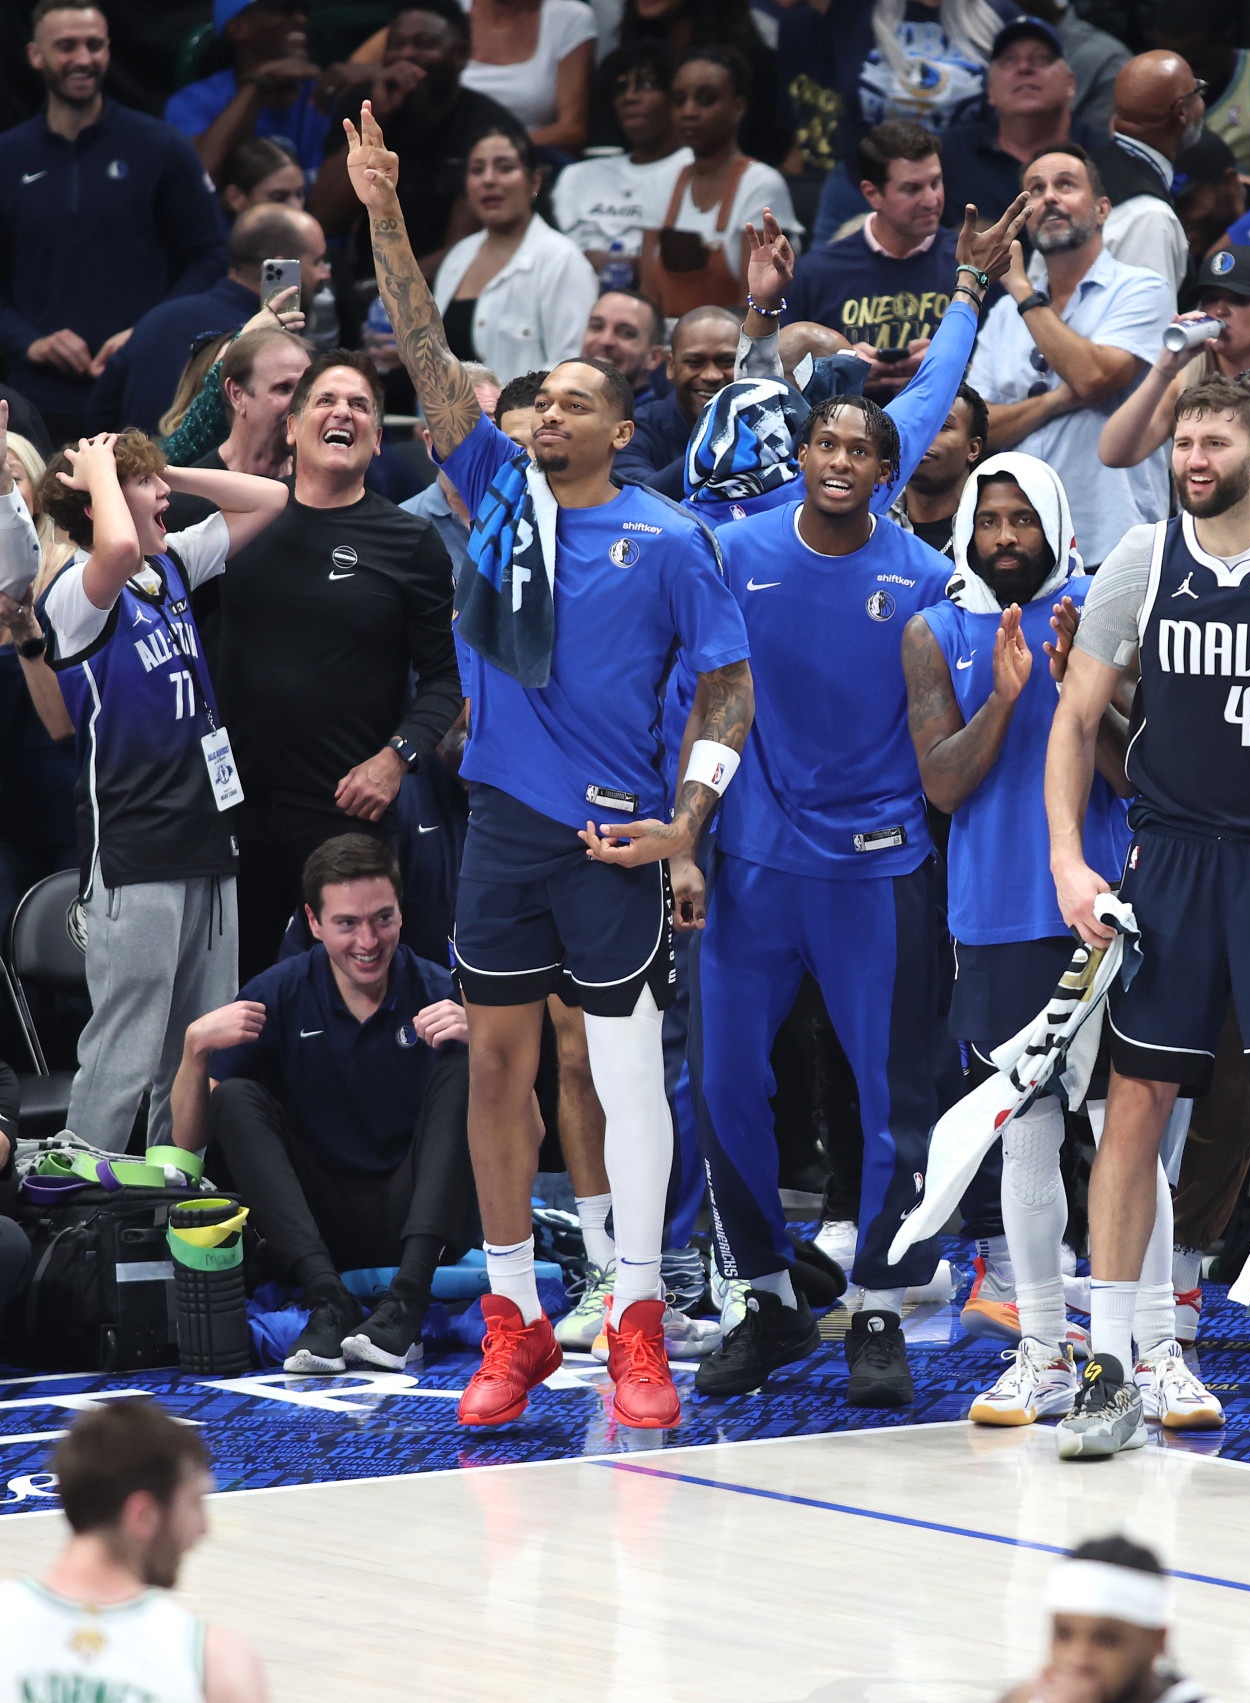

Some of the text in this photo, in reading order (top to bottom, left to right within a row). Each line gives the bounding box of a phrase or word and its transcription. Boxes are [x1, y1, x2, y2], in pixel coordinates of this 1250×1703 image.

[842, 292, 951, 327] ONE FO
[622, 521, 663, 536] shiftkey
[876, 573, 916, 588] shiftkey
[169, 670, 196, 720] 77
[712, 1206, 739, 1278] MAVERICKS
[806, 1411, 910, 1422] GREEN
[326, 1447, 529, 1460] DALE ELLIS
